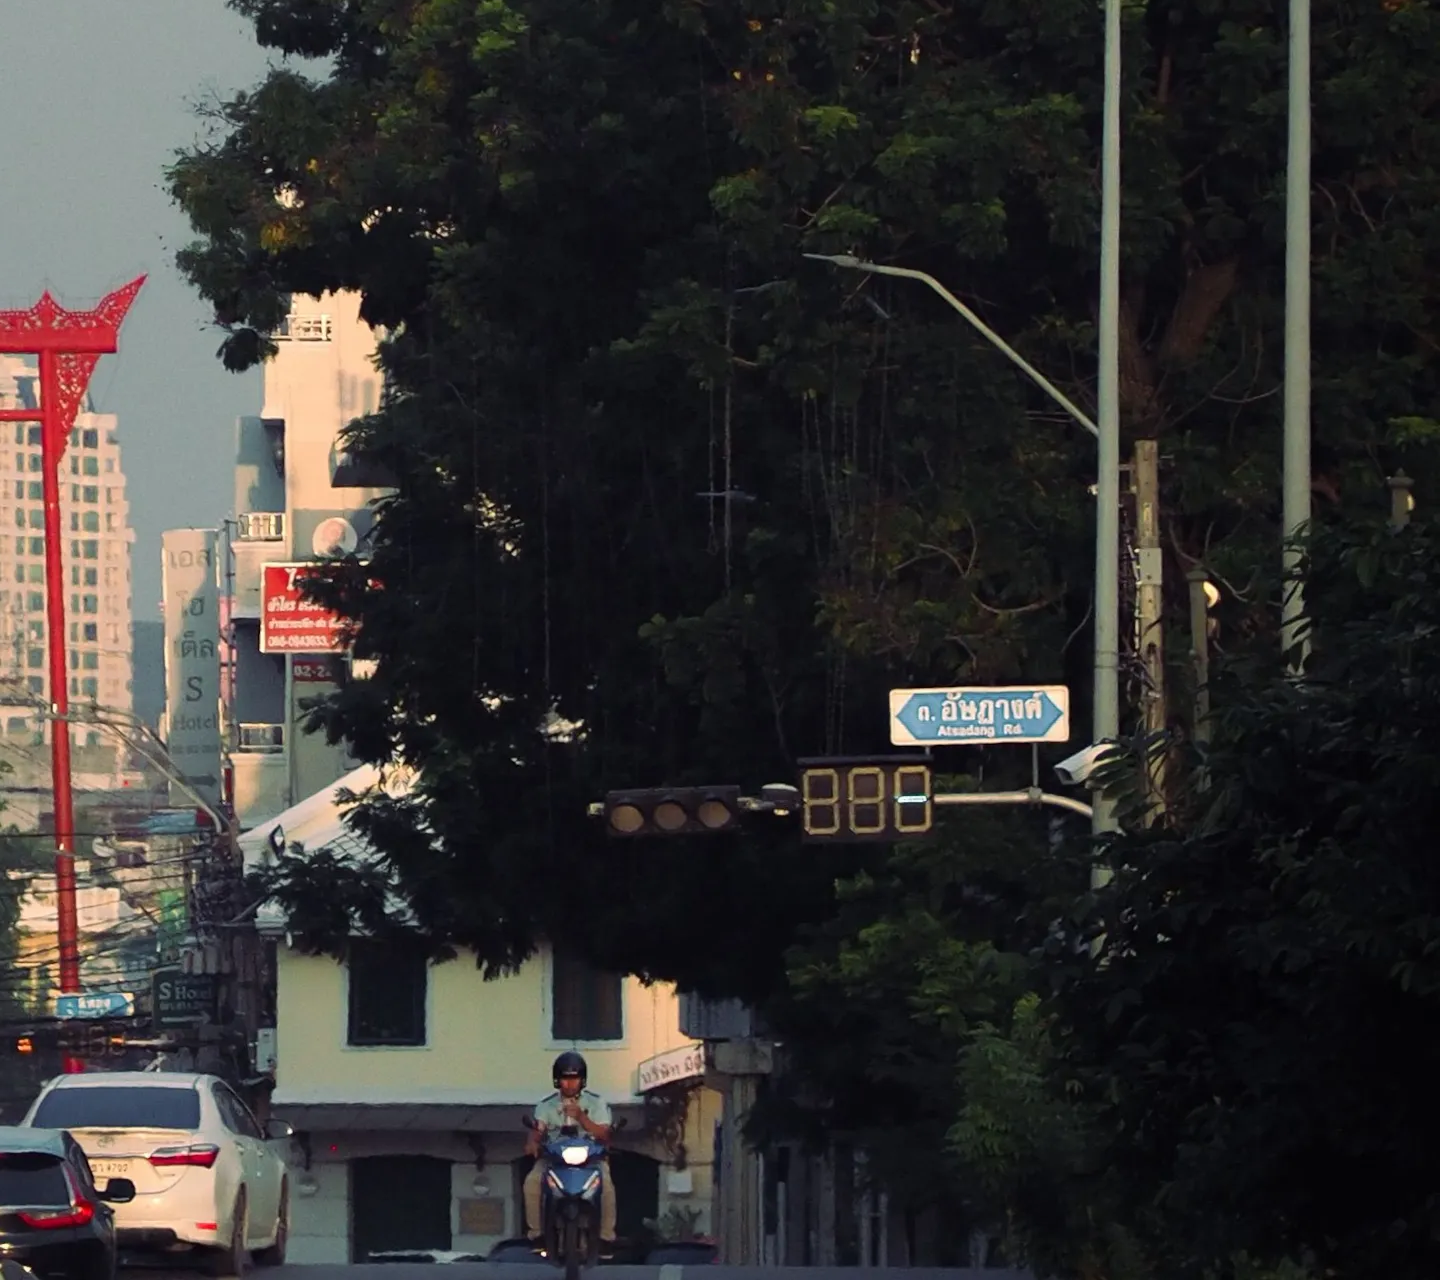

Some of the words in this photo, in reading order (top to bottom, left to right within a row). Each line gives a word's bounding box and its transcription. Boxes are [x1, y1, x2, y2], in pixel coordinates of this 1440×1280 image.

[185, 676, 203, 702] S
[937, 725, 995, 738] Atsadang
[159, 982, 172, 1000] S
